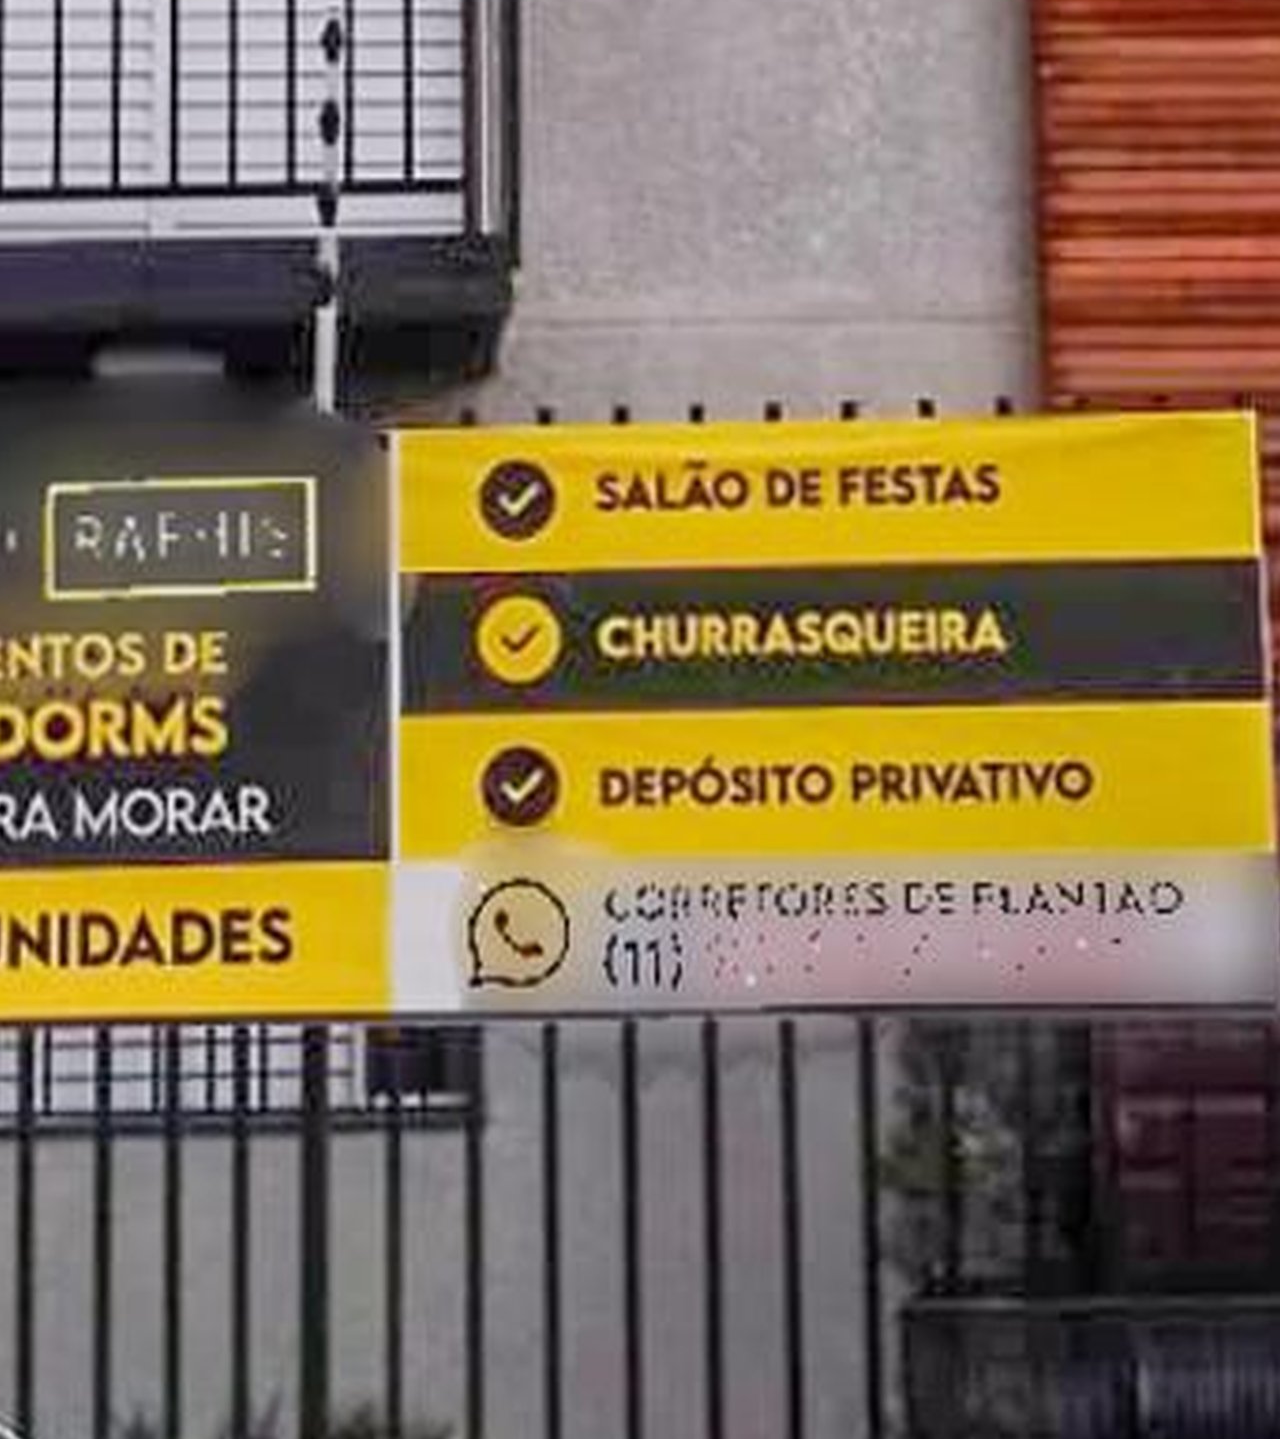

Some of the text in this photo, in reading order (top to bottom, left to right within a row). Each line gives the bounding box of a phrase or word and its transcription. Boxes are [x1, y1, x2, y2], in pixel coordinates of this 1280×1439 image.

[596, 460, 1001, 511] SALÃO DE FESTAS
[164, 632, 228, 676] DE
[596, 610, 1009, 660] CHURRASQUEIRA
[598, 757, 1094, 807] DEPÓSITO PRIVATIVO
[76, 786, 272, 840] MORAR
